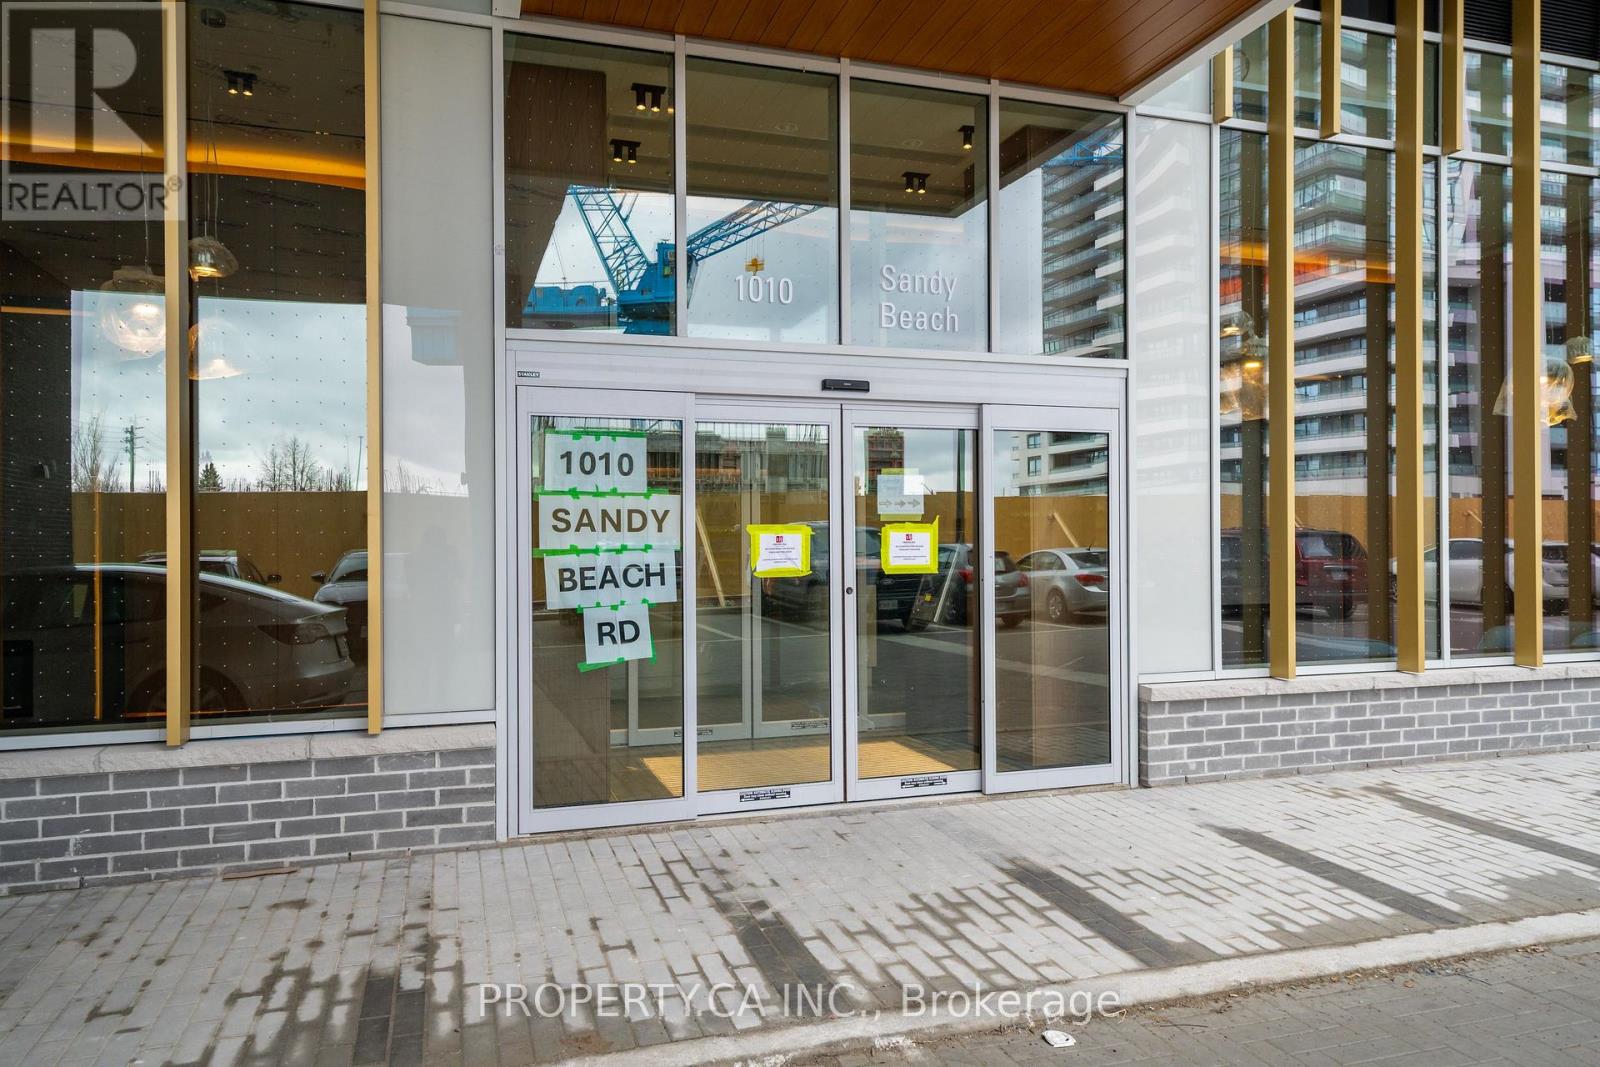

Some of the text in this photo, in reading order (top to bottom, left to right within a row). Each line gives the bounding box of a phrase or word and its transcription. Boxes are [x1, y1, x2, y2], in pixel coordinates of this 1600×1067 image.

[735, 273, 794, 304] 1010
[881, 264, 957, 301] Sandy
[880, 302, 960, 332] Beach
[559, 450, 634, 476] 1010
[551, 508, 670, 533] SANDY
[558, 562, 666, 592] BEACH
[597, 619, 640, 646] RD
